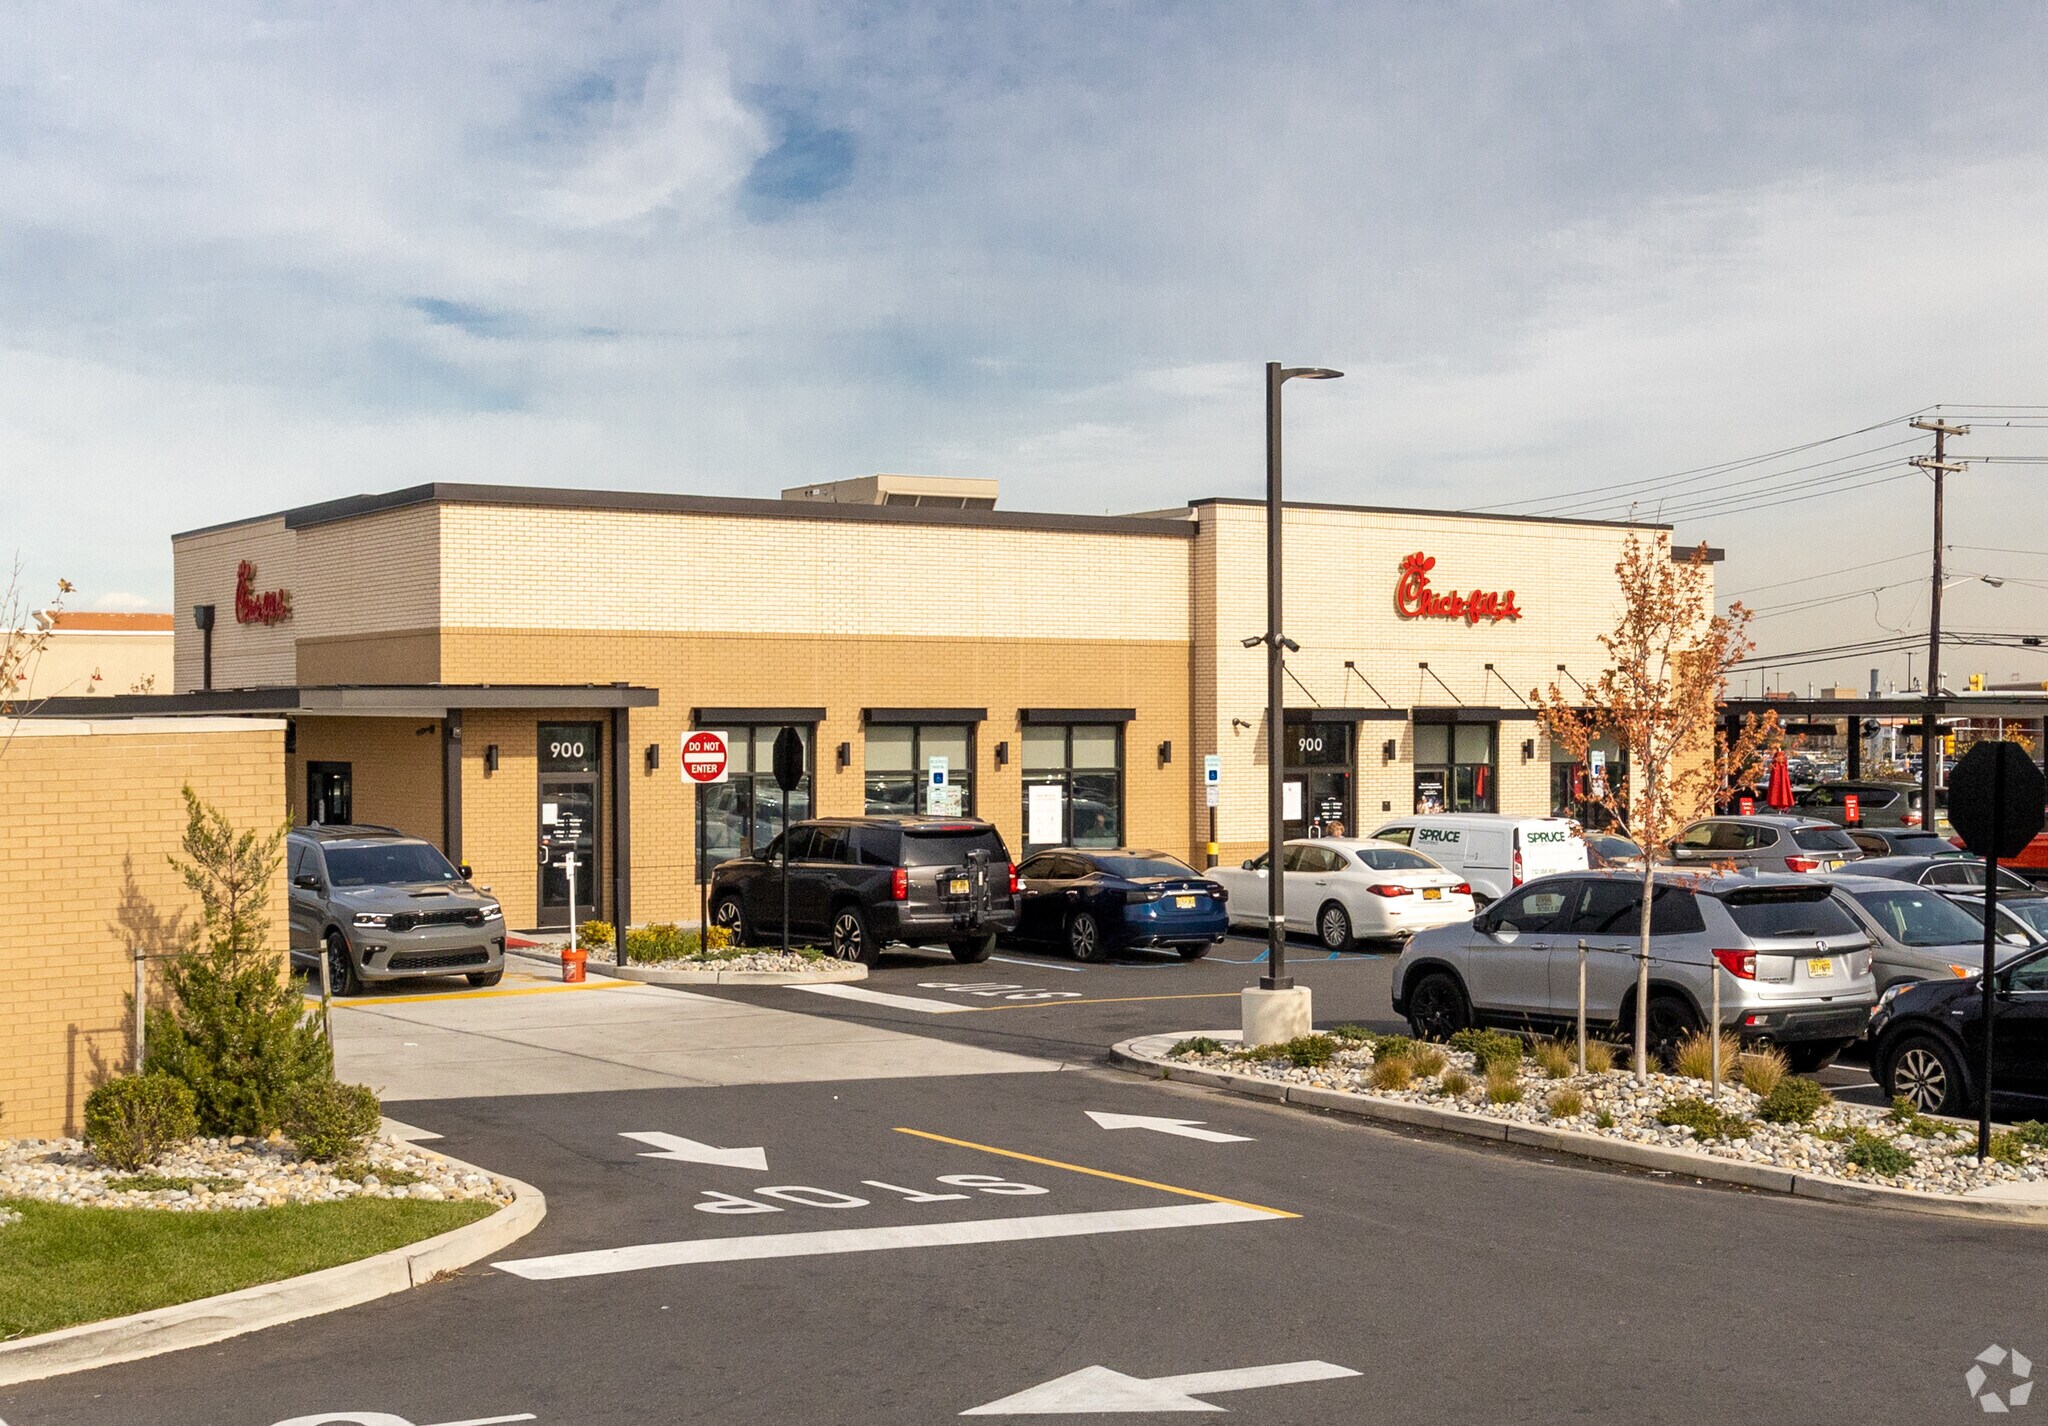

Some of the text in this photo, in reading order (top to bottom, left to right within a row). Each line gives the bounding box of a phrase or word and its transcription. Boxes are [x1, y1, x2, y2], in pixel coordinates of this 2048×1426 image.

[1397, 551, 1523, 624] Chick-fil-A
[550, 741, 584, 758] 900
[689, 741, 720, 751] DO NOT
[1298, 737, 1323, 752] 900
[691, 764, 718, 774] ENTER
[1418, 828, 1461, 843] SPRUCE
[1526, 831, 1566, 843] SPRUCE
[693, 1173, 1051, 1214] STOP
